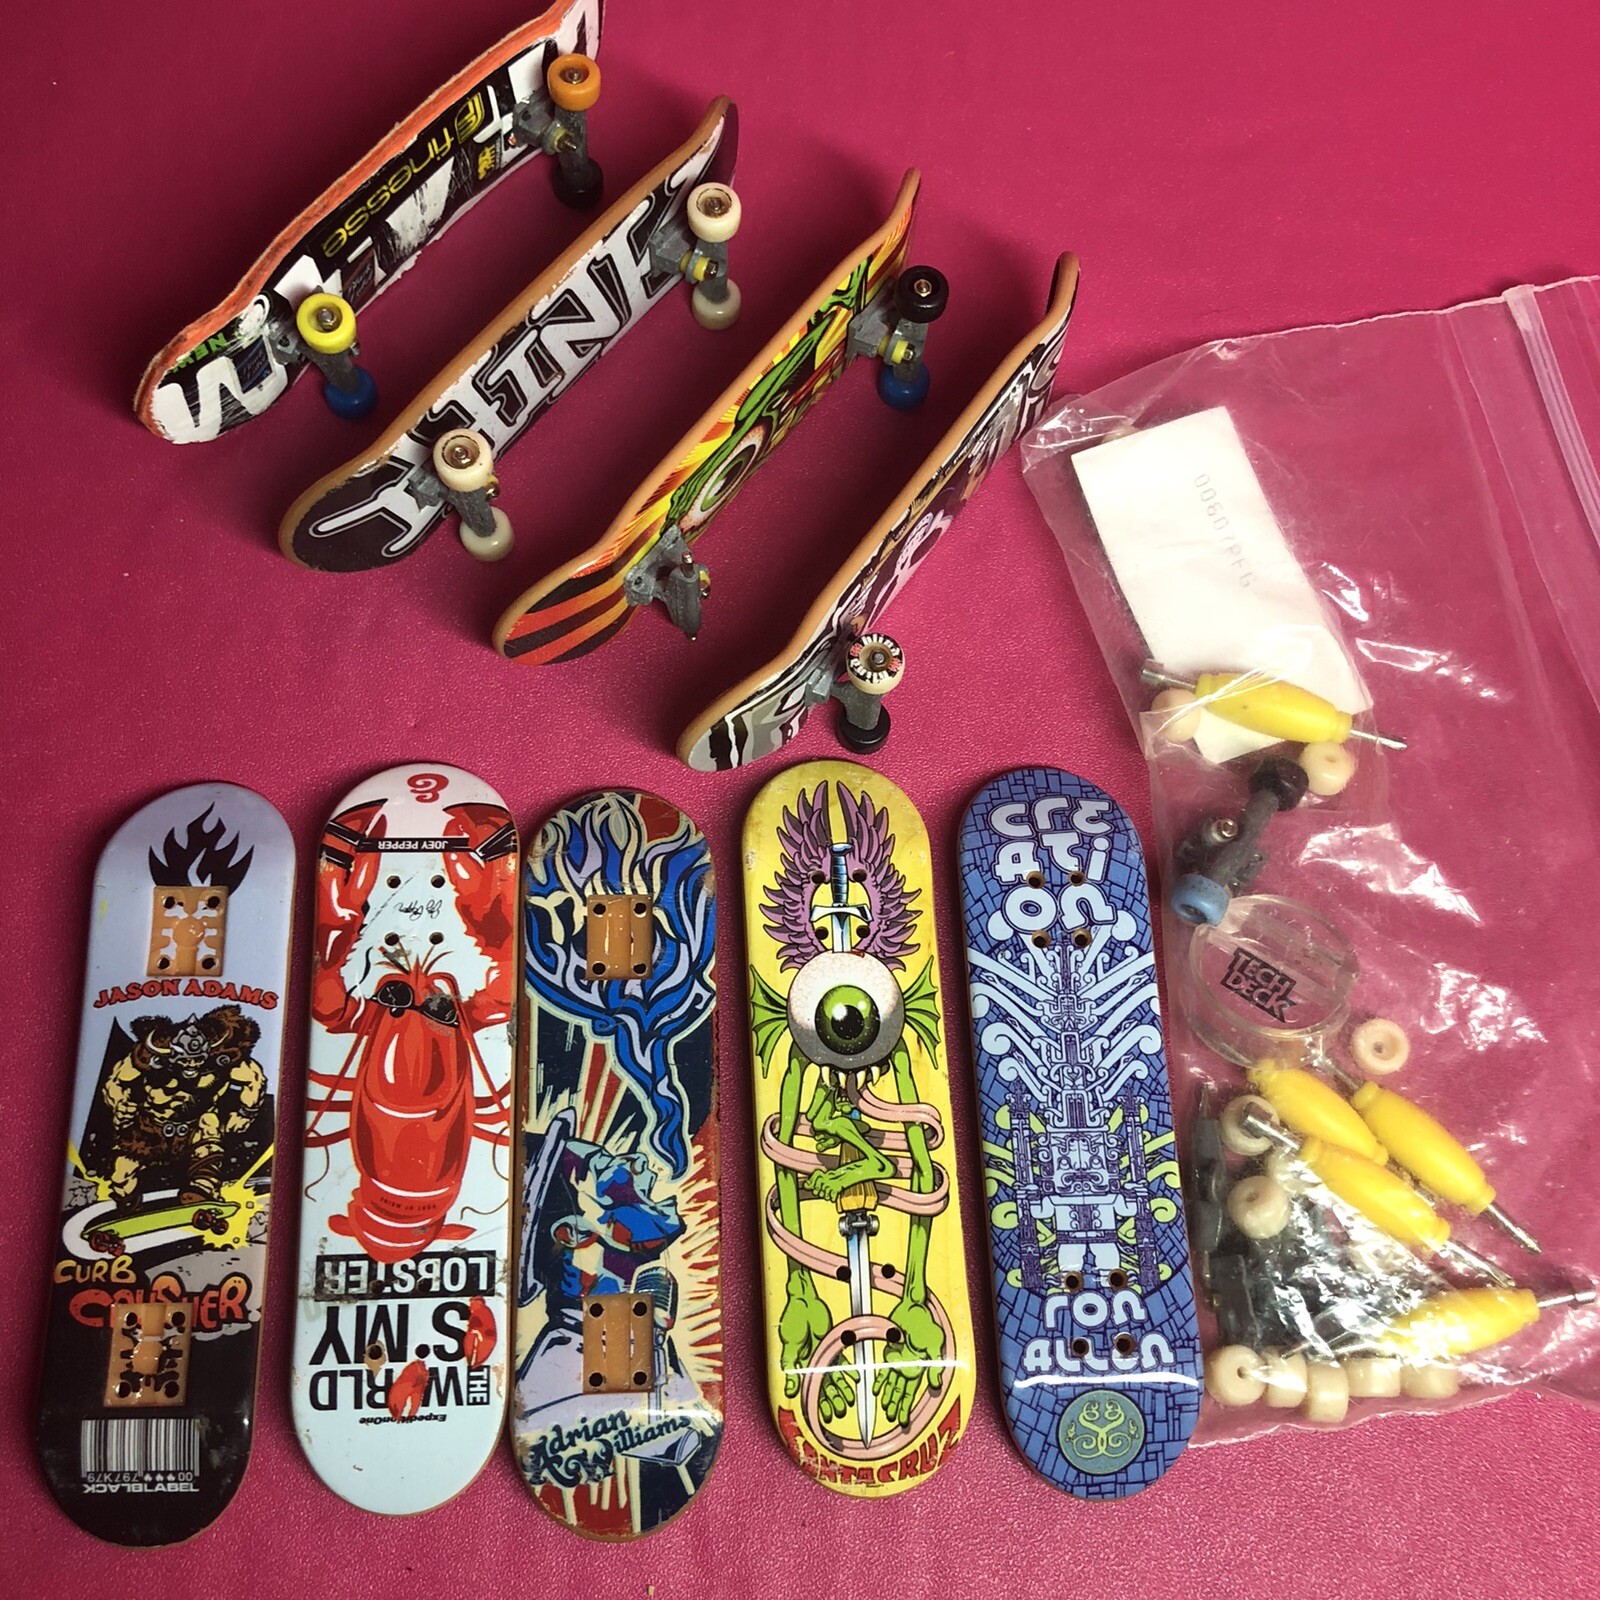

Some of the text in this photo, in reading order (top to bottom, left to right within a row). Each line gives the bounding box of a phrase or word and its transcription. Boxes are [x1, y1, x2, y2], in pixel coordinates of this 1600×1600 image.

[322, 124, 454, 259] finesse
[378, 839, 449, 850] JOEY PEPPER
[93, 978, 280, 1010] JASON ADAMS
[1225, 968, 1291, 1018] DECK
[1236, 951, 1291, 997] TECH
[54, 1254, 137, 1285] CURB
[323, 1256, 489, 1293] LOBSTER
[308, 1303, 410, 1366] MY
[308, 1366, 488, 1412] THE WRLD
[528, 1409, 632, 1488] Adrian
